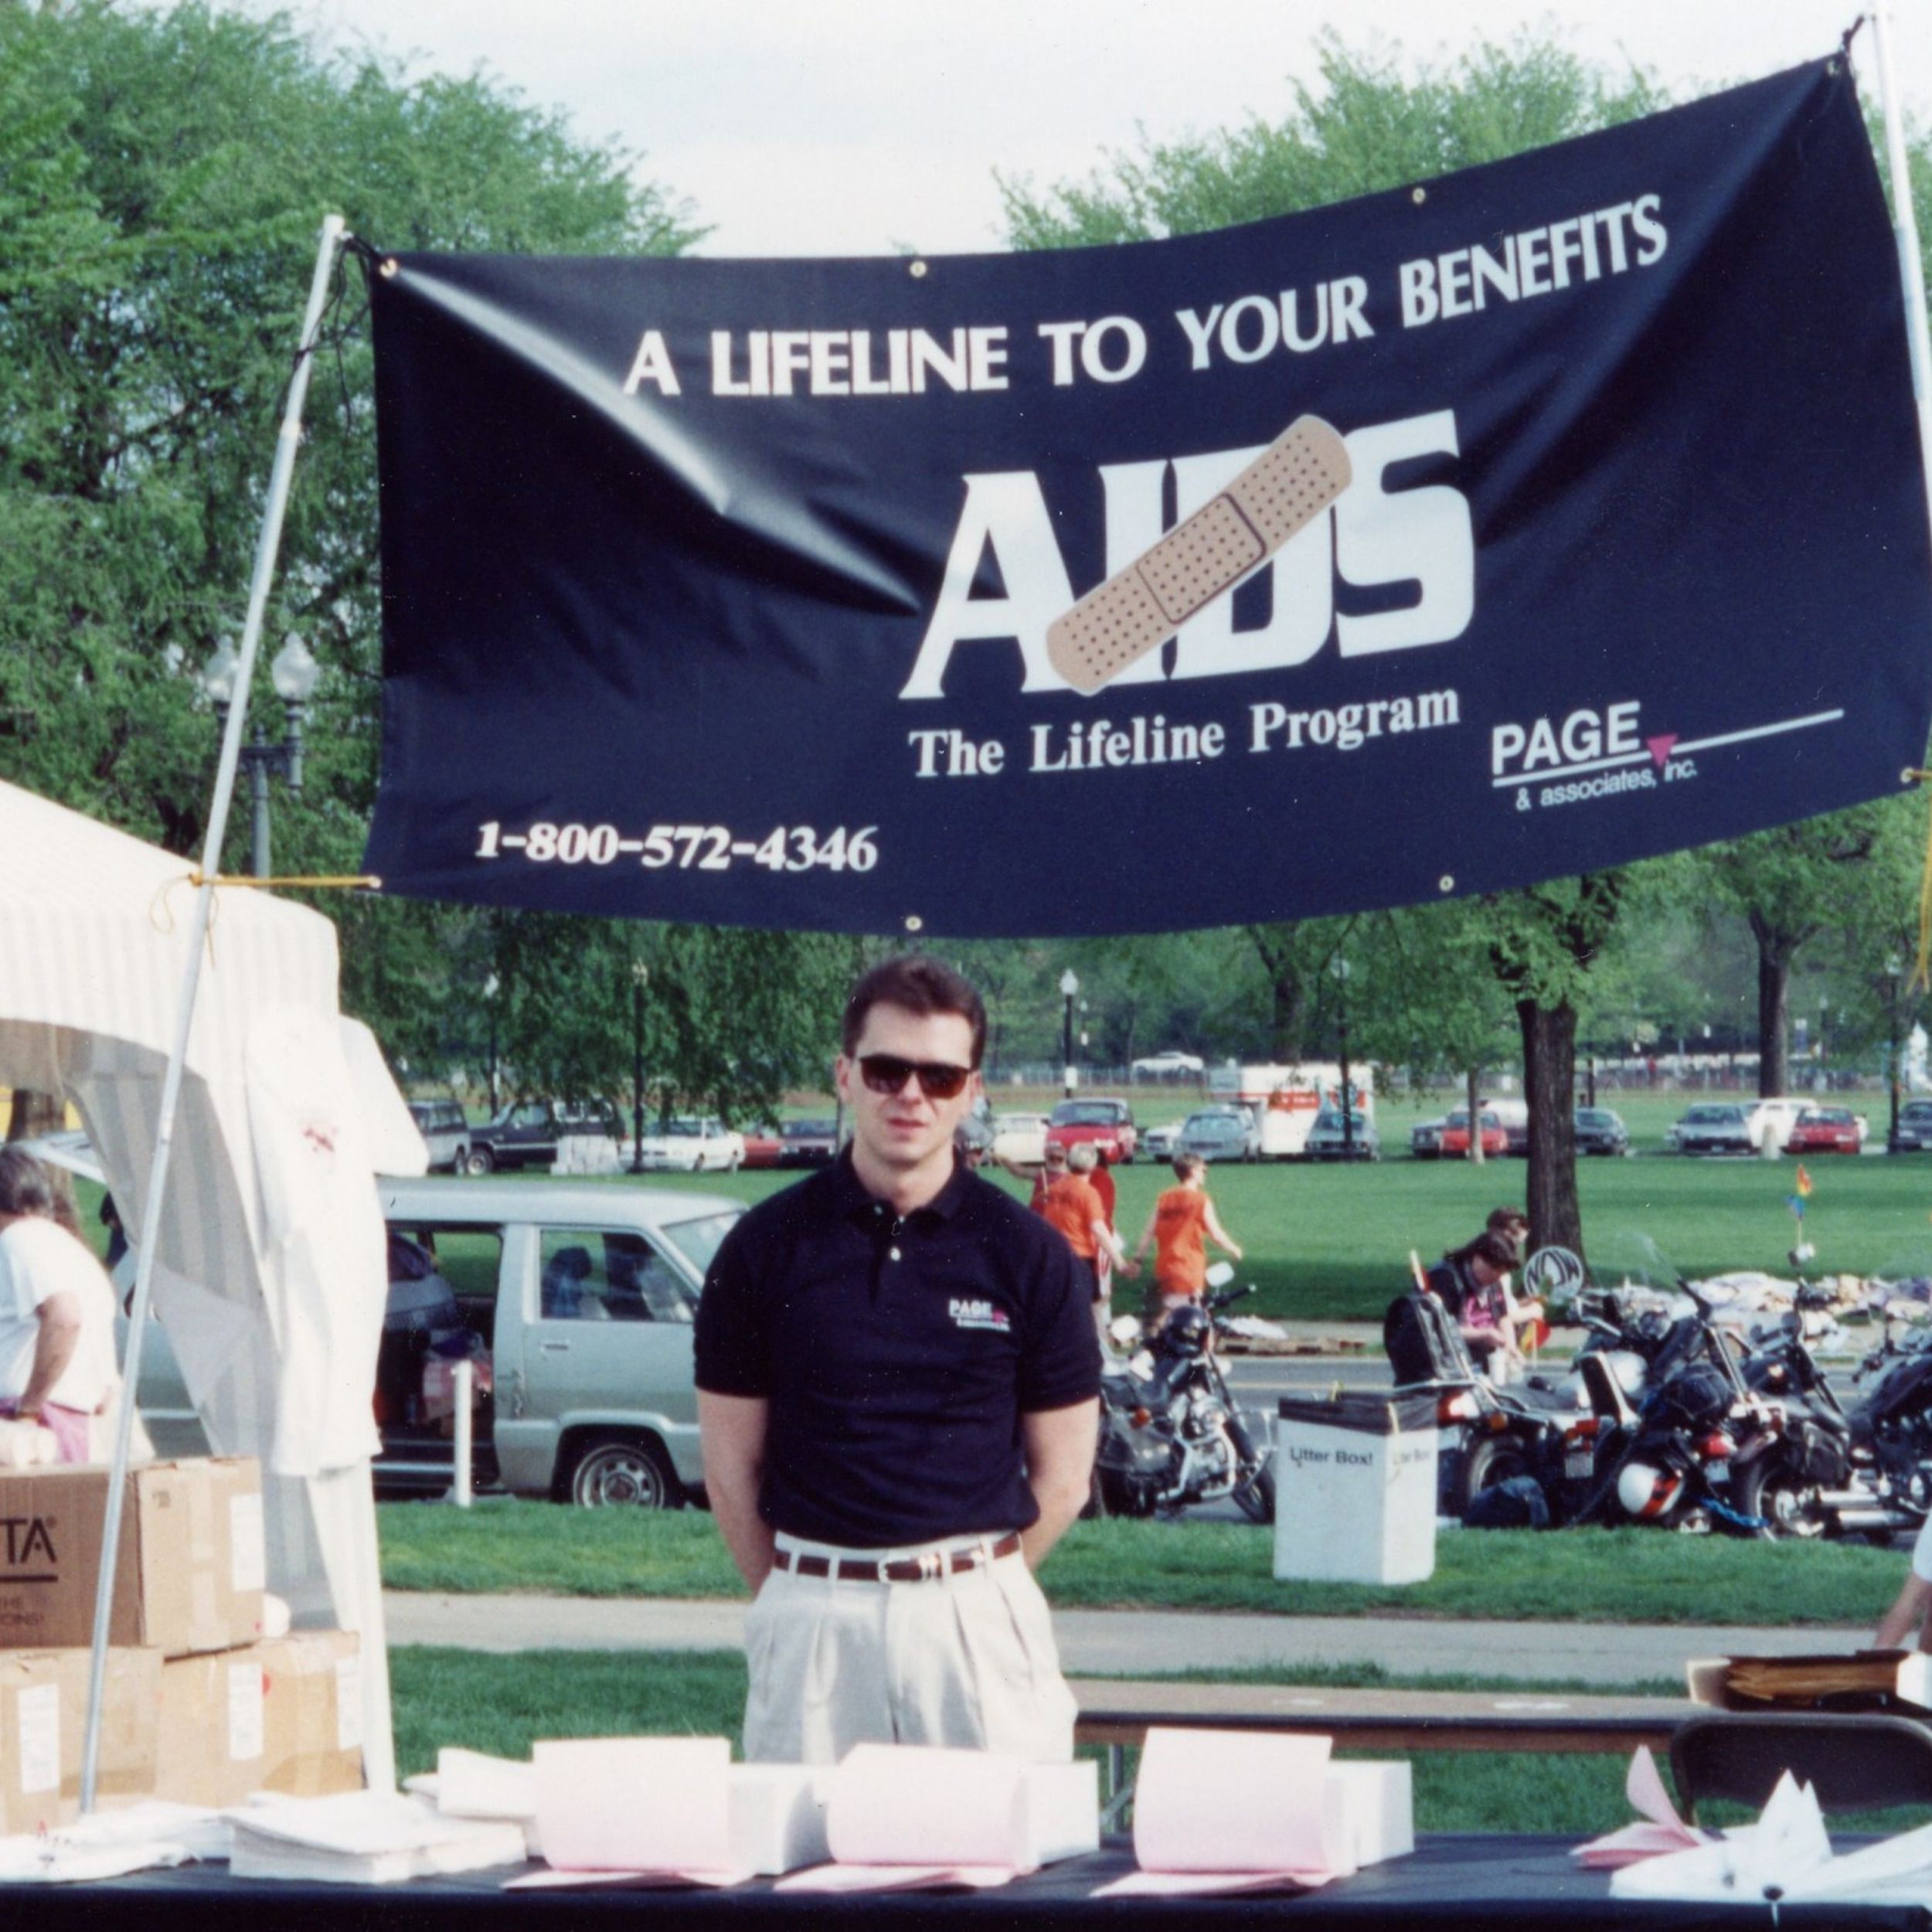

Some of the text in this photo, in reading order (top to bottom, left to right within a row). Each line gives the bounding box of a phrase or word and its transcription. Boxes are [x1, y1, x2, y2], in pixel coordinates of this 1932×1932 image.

[623, 194, 1668, 398] A LIFELINE TO YOUR BENEFITS
[898, 409, 1475, 700] AIDS
[909, 689, 1460, 777] The Lifeline Program
[1492, 700, 1641, 775] PAGE
[1515, 760, 1697, 811] & associates, inc.
[474, 821, 879, 872] 1-800-572-4346
[1290, 1447, 1373, 1466] Litter Box!
